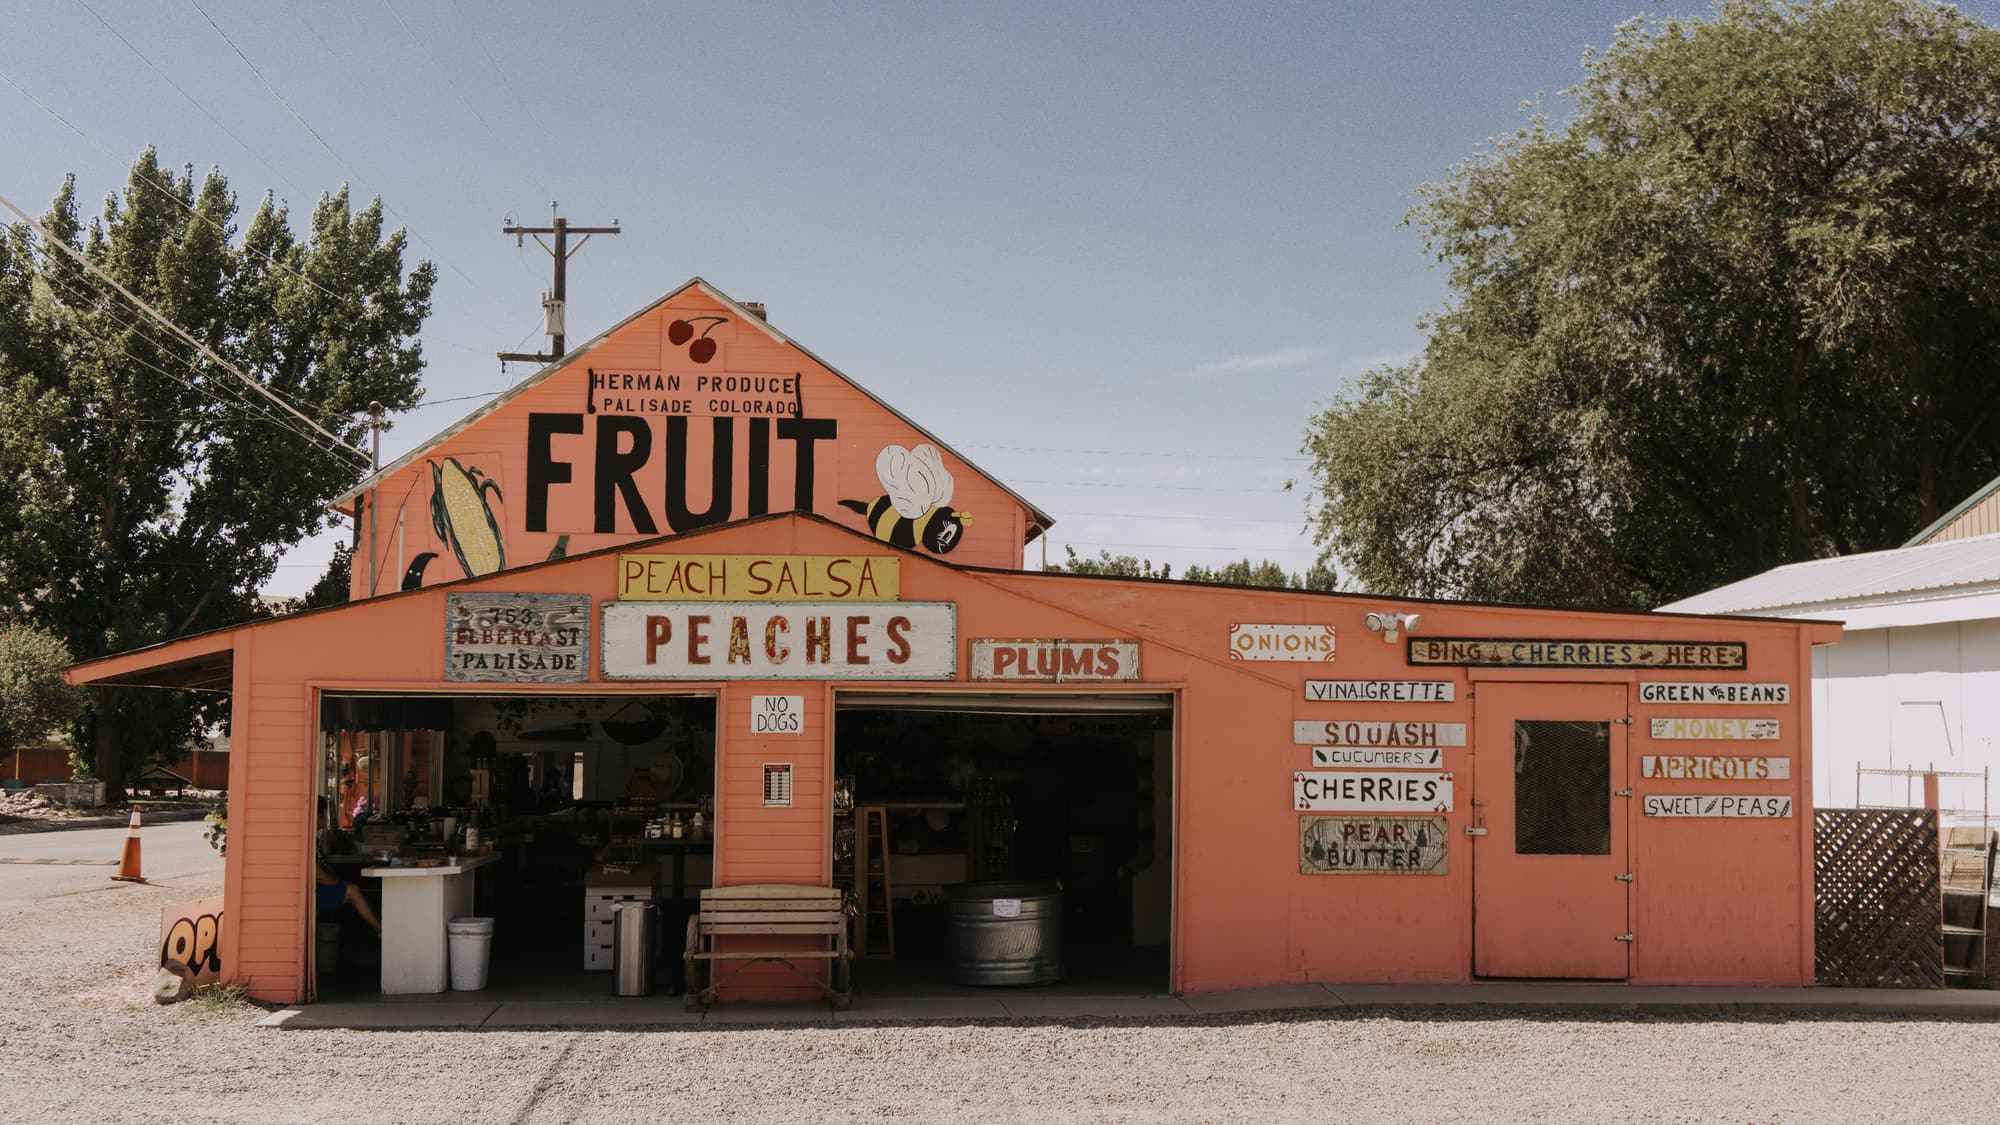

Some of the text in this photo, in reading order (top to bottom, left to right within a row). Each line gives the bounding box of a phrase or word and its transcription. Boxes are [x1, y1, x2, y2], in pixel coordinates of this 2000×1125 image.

[593, 373, 794, 394] HERMAN PRODUCE
[603, 398, 797, 414] PALISADE COLORADO
[526, 412, 837, 533] FRUIT
[625, 557, 878, 597] PEACH SALSA
[489, 608, 532, 624] 753
[456, 627, 580, 646] ELBERTA ST
[646, 615, 912, 665] PEACHES
[1236, 633, 1331, 652] ONIONS
[462, 653, 577, 670] PALISADE
[992, 647, 1120, 677] PLUMS
[1428, 641, 1729, 665] BING CHERRIES HERE
[1312, 682, 1446, 701] VINAIGRETTE
[1643, 685, 1786, 702] GREEN BEANS
[765, 696, 788, 713] NO
[756, 713, 798, 732] DOGS
[1673, 719, 1749, 739] HONEY
[1325, 722, 1437, 746] SQUASH
[1331, 751, 1424, 765] CUCUMBERS
[1652, 757, 1769, 779] APRICOTS
[1303, 777, 1438, 802] CHERRIES
[1648, 797, 1778, 816] SWEET PEAS
[1344, 823, 1405, 843] PEAR
[1328, 847, 1421, 867] BUTTER
